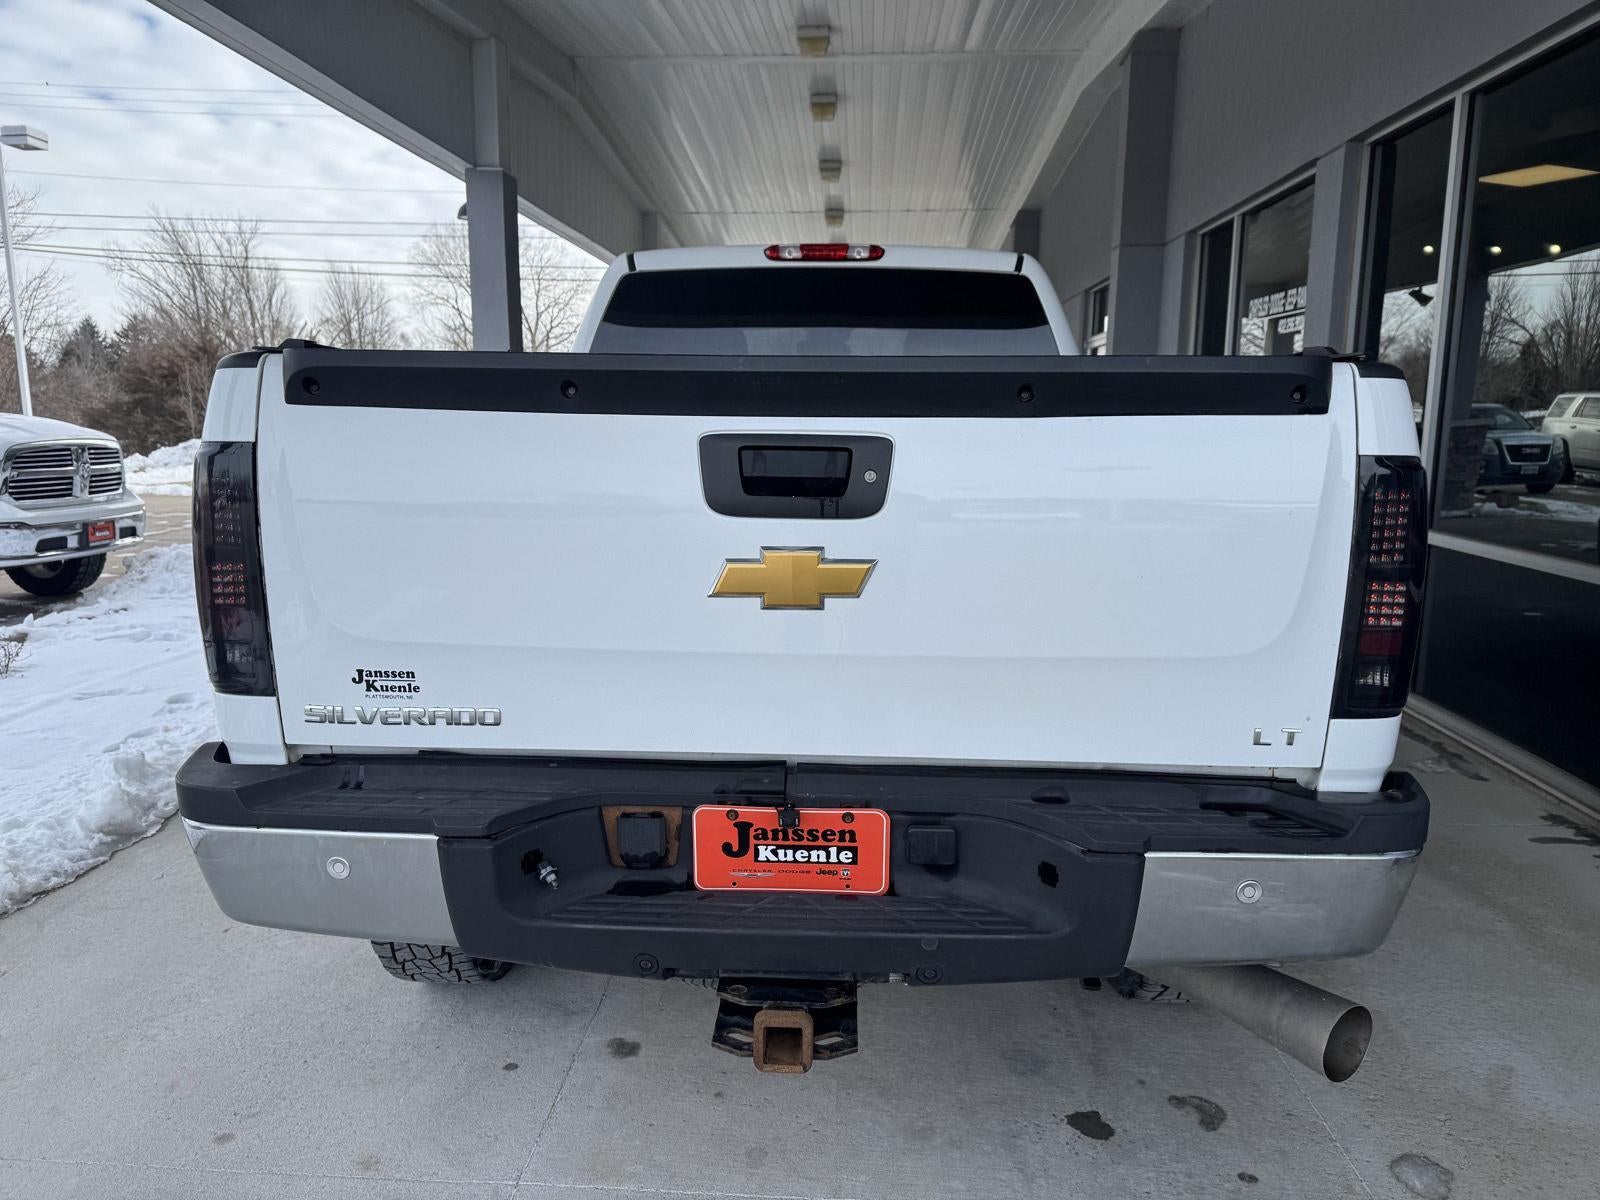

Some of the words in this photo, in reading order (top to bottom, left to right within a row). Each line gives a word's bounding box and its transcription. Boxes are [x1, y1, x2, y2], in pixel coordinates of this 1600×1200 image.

[352, 669, 416, 684] Janssen
[365, 679, 420, 693] Kuenle
[304, 704, 502, 726] SILVERADO
[1253, 728, 1302, 746] LT
[722, 821, 857, 858] Janssen
[757, 845, 853, 863] Kuenle
[815, 868, 838, 877] Jeep
